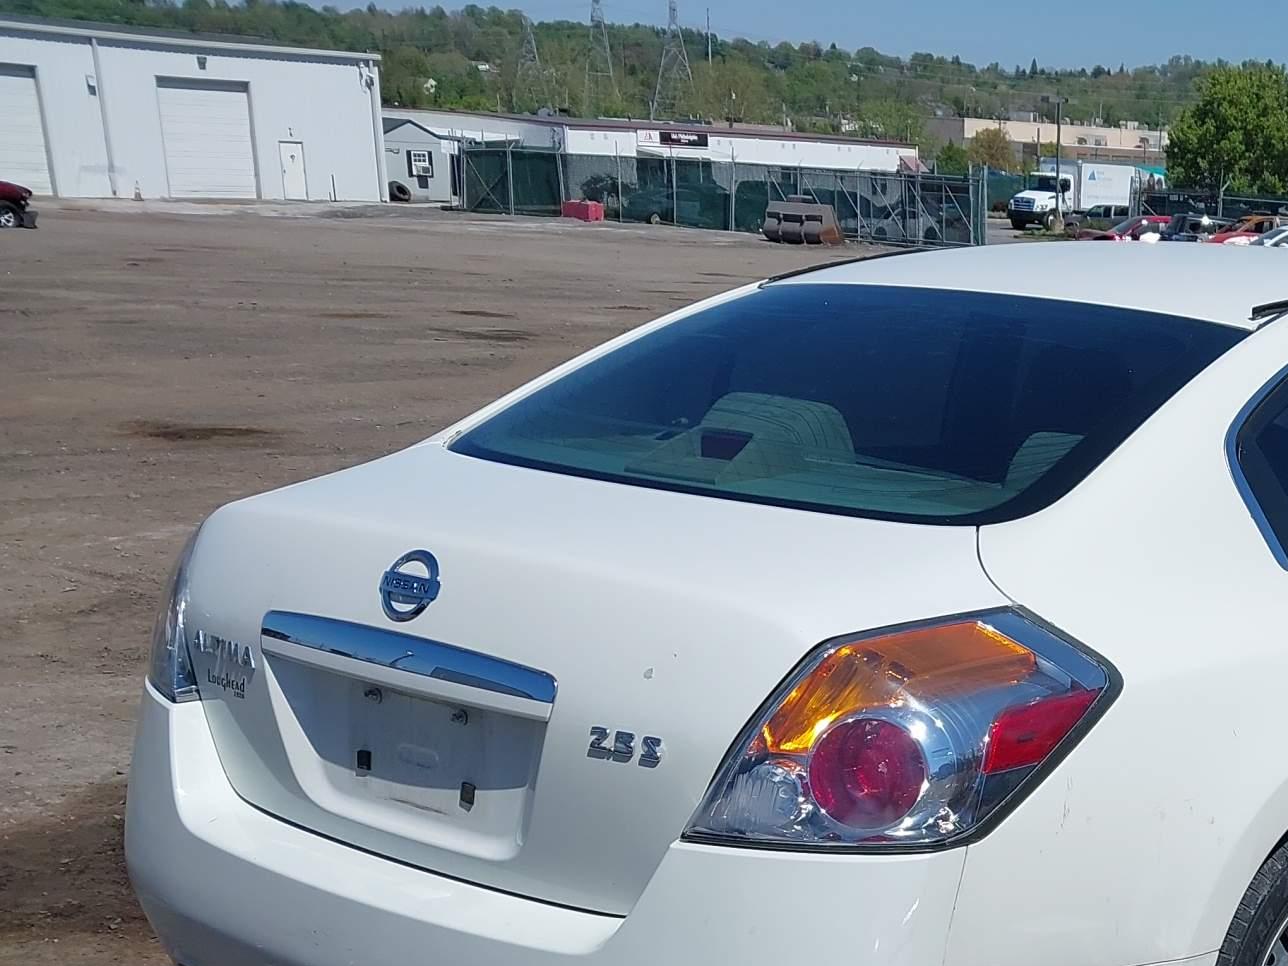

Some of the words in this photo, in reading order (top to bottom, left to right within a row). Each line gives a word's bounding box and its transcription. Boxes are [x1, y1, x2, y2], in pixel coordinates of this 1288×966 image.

[383, 572, 430, 594] NISSAN
[194, 629, 256, 669] ALTIMA
[638, 736, 662, 768] S
